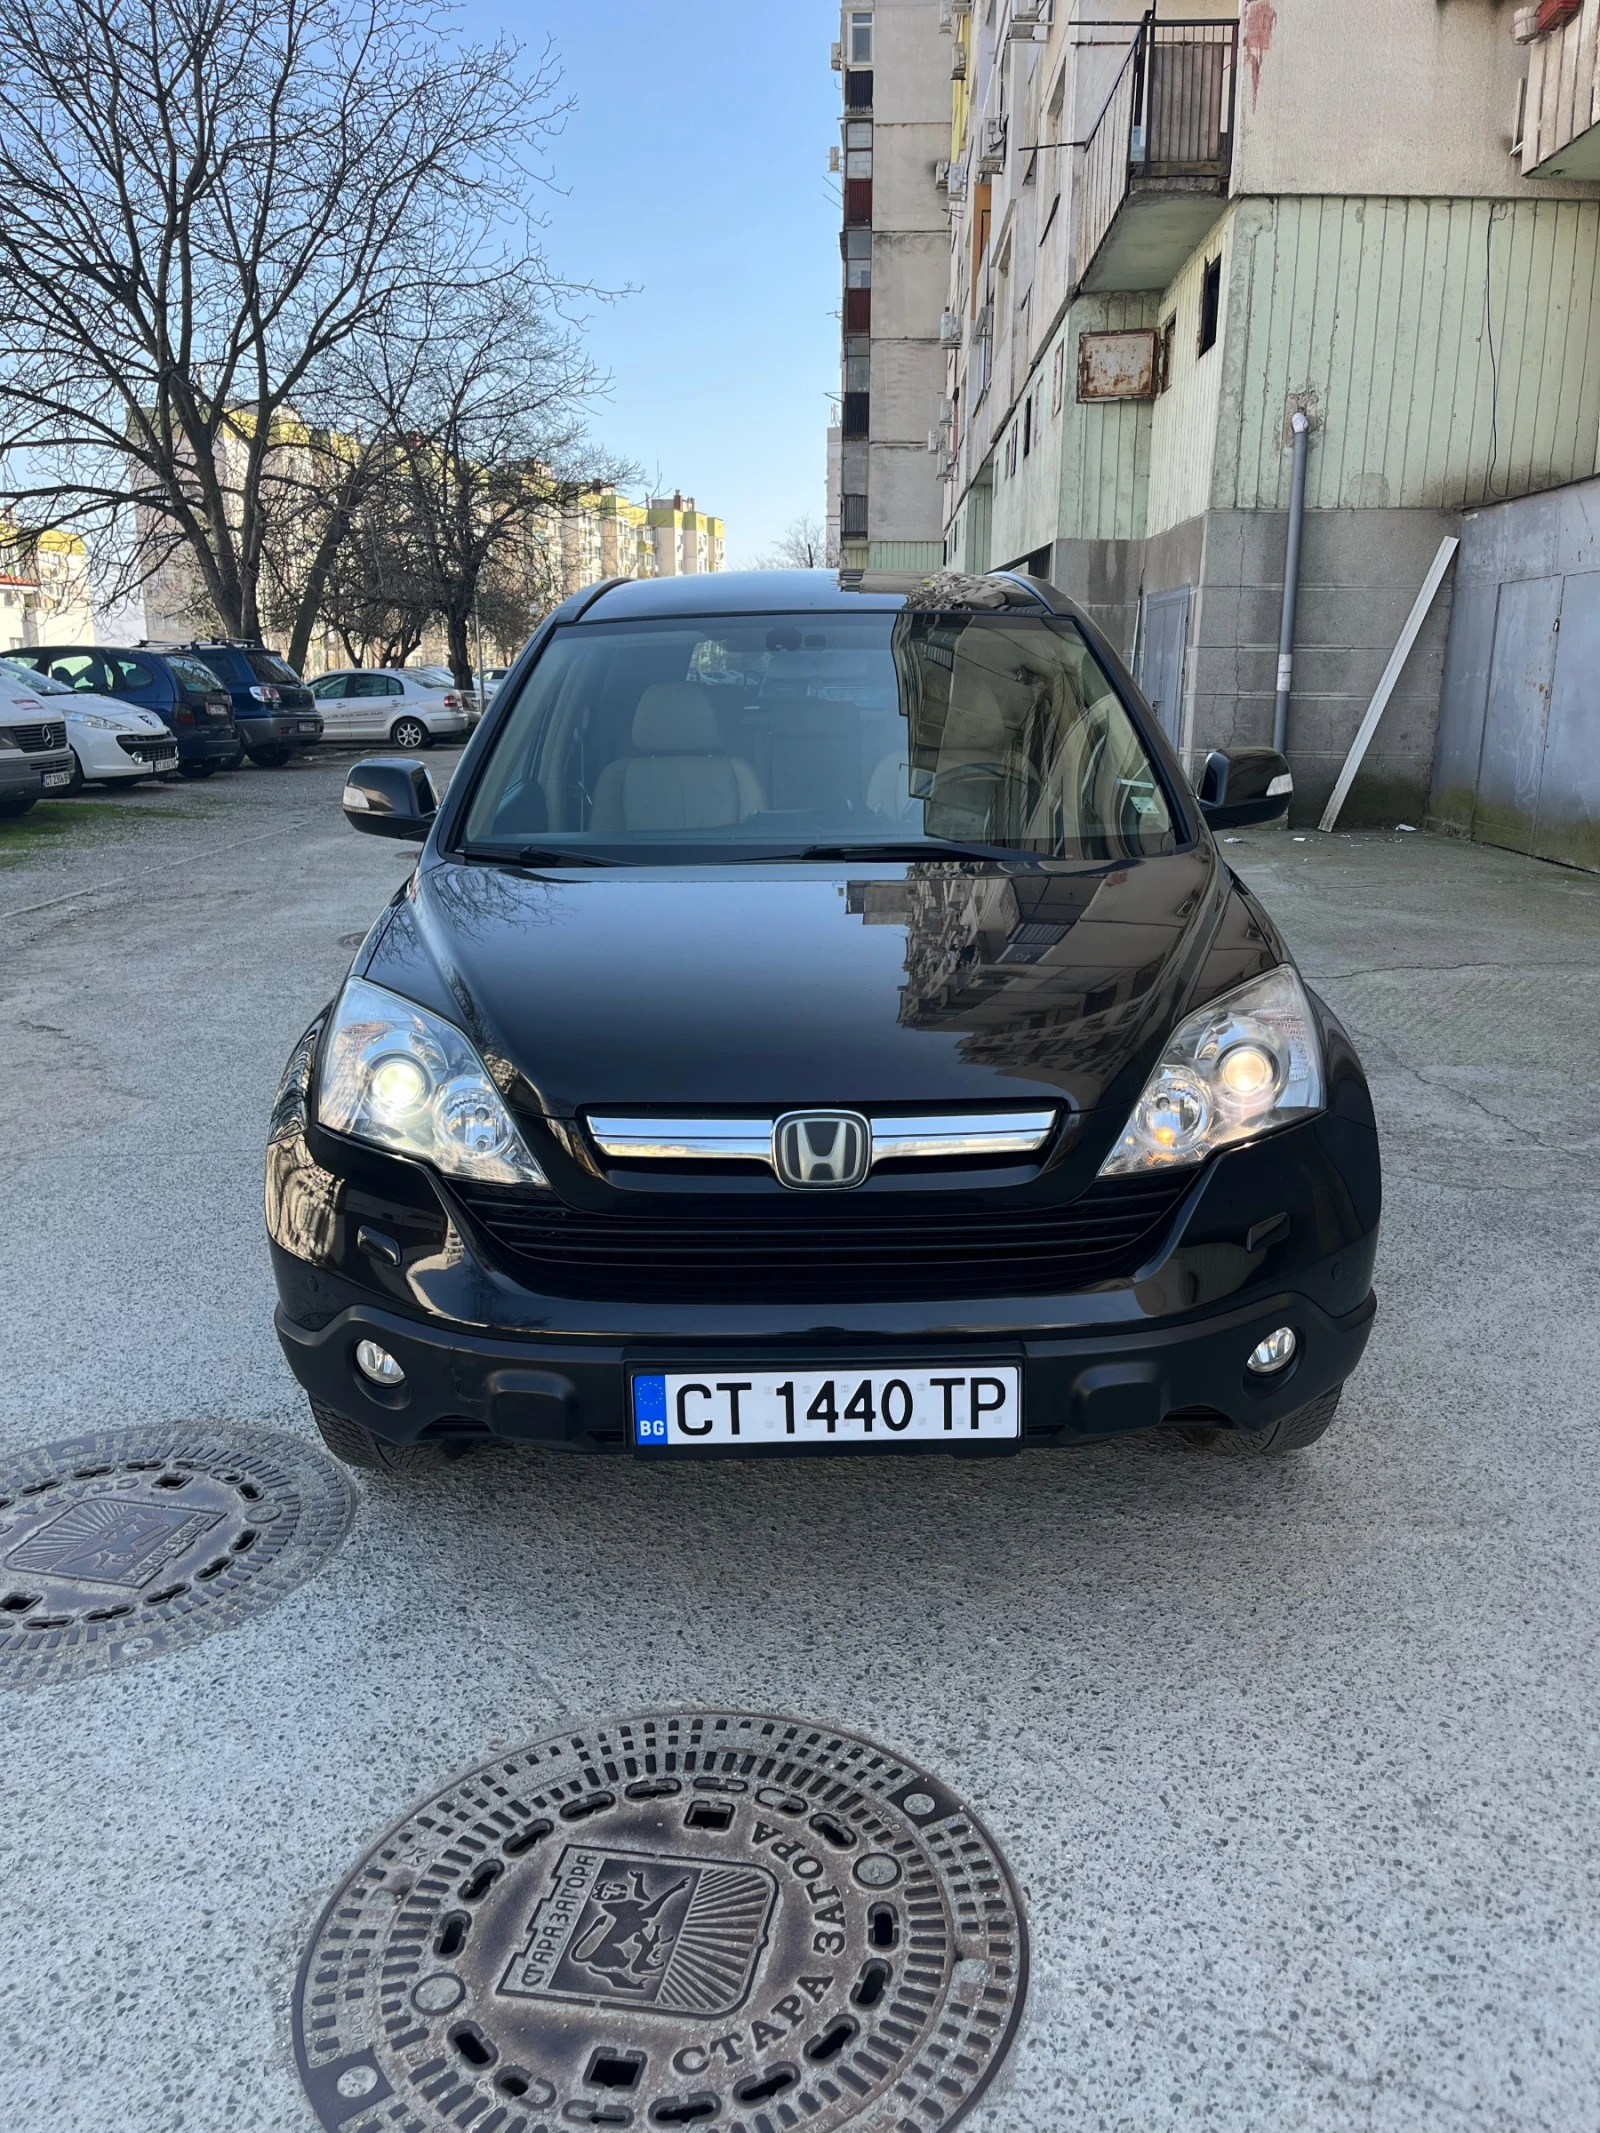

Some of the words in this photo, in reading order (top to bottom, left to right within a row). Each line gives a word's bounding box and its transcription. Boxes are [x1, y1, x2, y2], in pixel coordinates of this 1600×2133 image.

[640, 1420, 665, 1436] BG
[676, 1382, 752, 1436] CT
[776, 1379, 913, 1434] 1440
[930, 1377, 1006, 1430] TP
[752, 1821, 847, 1957] ЗАГОРА
[672, 1975, 834, 2076] СТАРА
